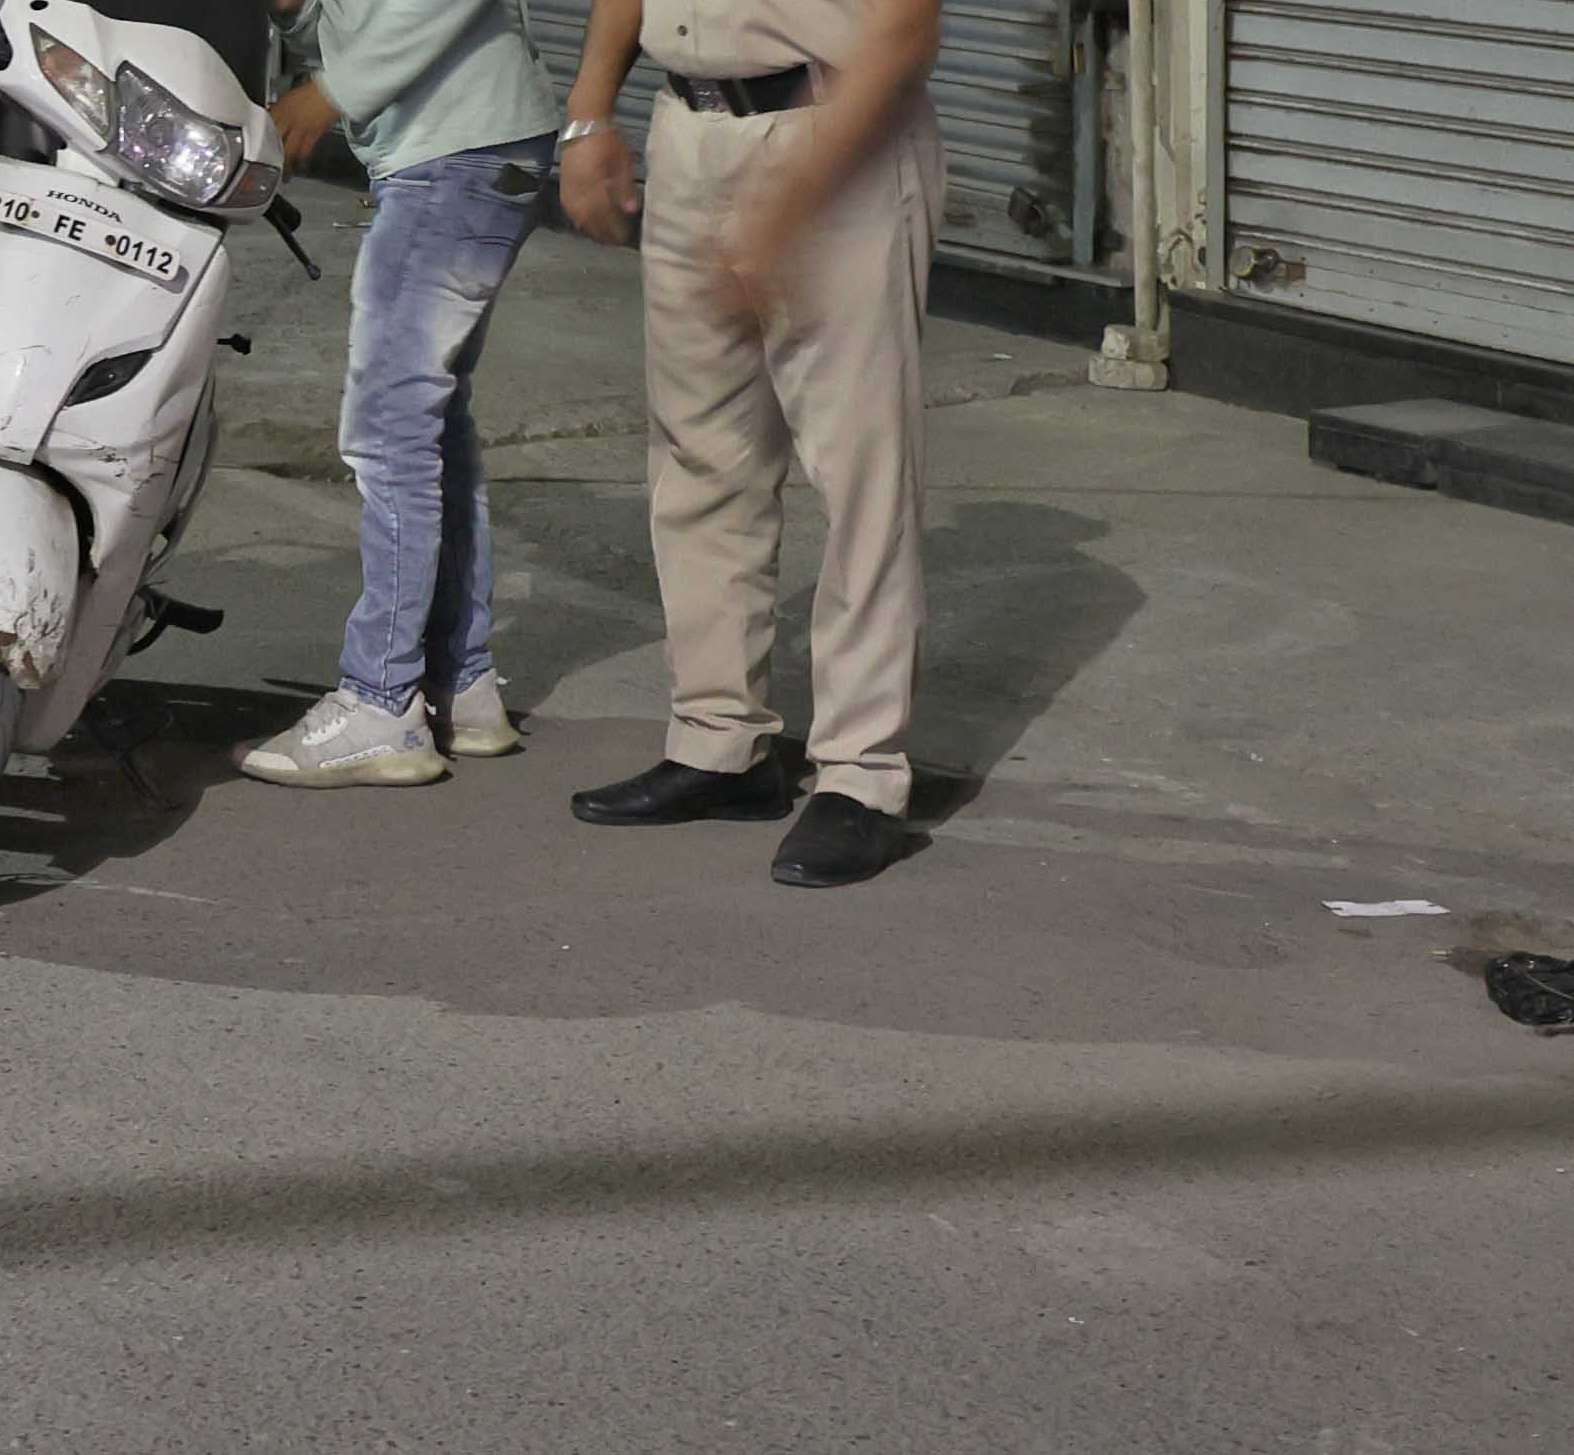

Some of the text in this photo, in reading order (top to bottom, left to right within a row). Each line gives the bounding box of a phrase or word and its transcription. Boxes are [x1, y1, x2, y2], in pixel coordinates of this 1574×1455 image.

[46, 190, 123, 223] HONDA
[54, 214, 86, 241] FE
[115, 235, 174, 274] 0112
